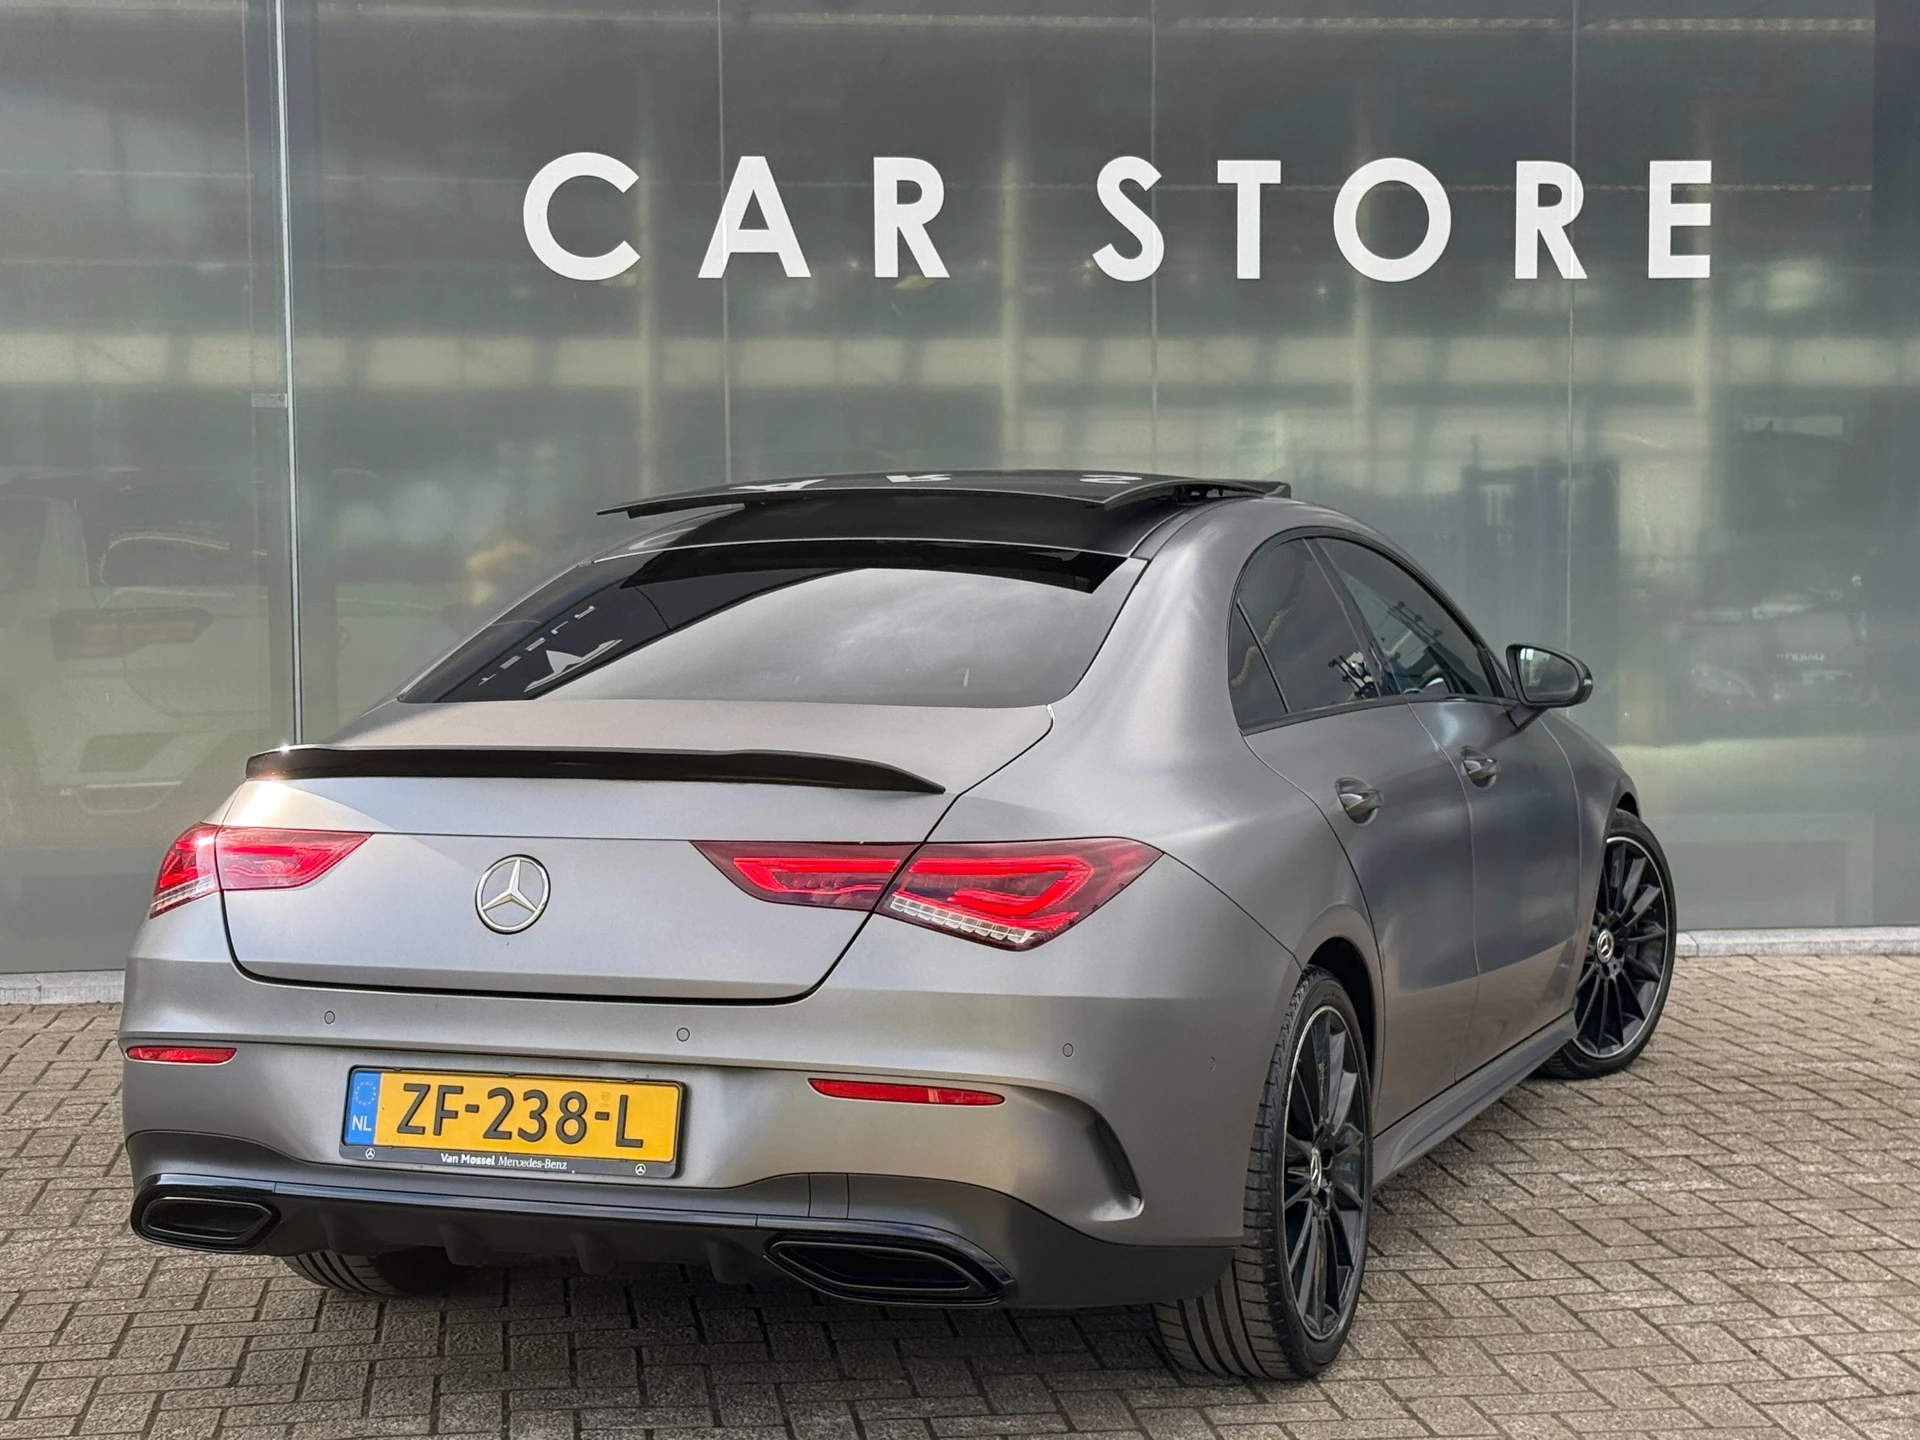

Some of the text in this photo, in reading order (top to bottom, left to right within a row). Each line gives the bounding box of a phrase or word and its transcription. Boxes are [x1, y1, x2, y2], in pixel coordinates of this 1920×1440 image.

[523, 152, 1712, 282] CAR STORE
[351, 1114, 373, 1132] NL
[396, 1083, 644, 1149] ZF-238-L
[440, 1152, 568, 1170] Van Mossel Mercedes-Benz
